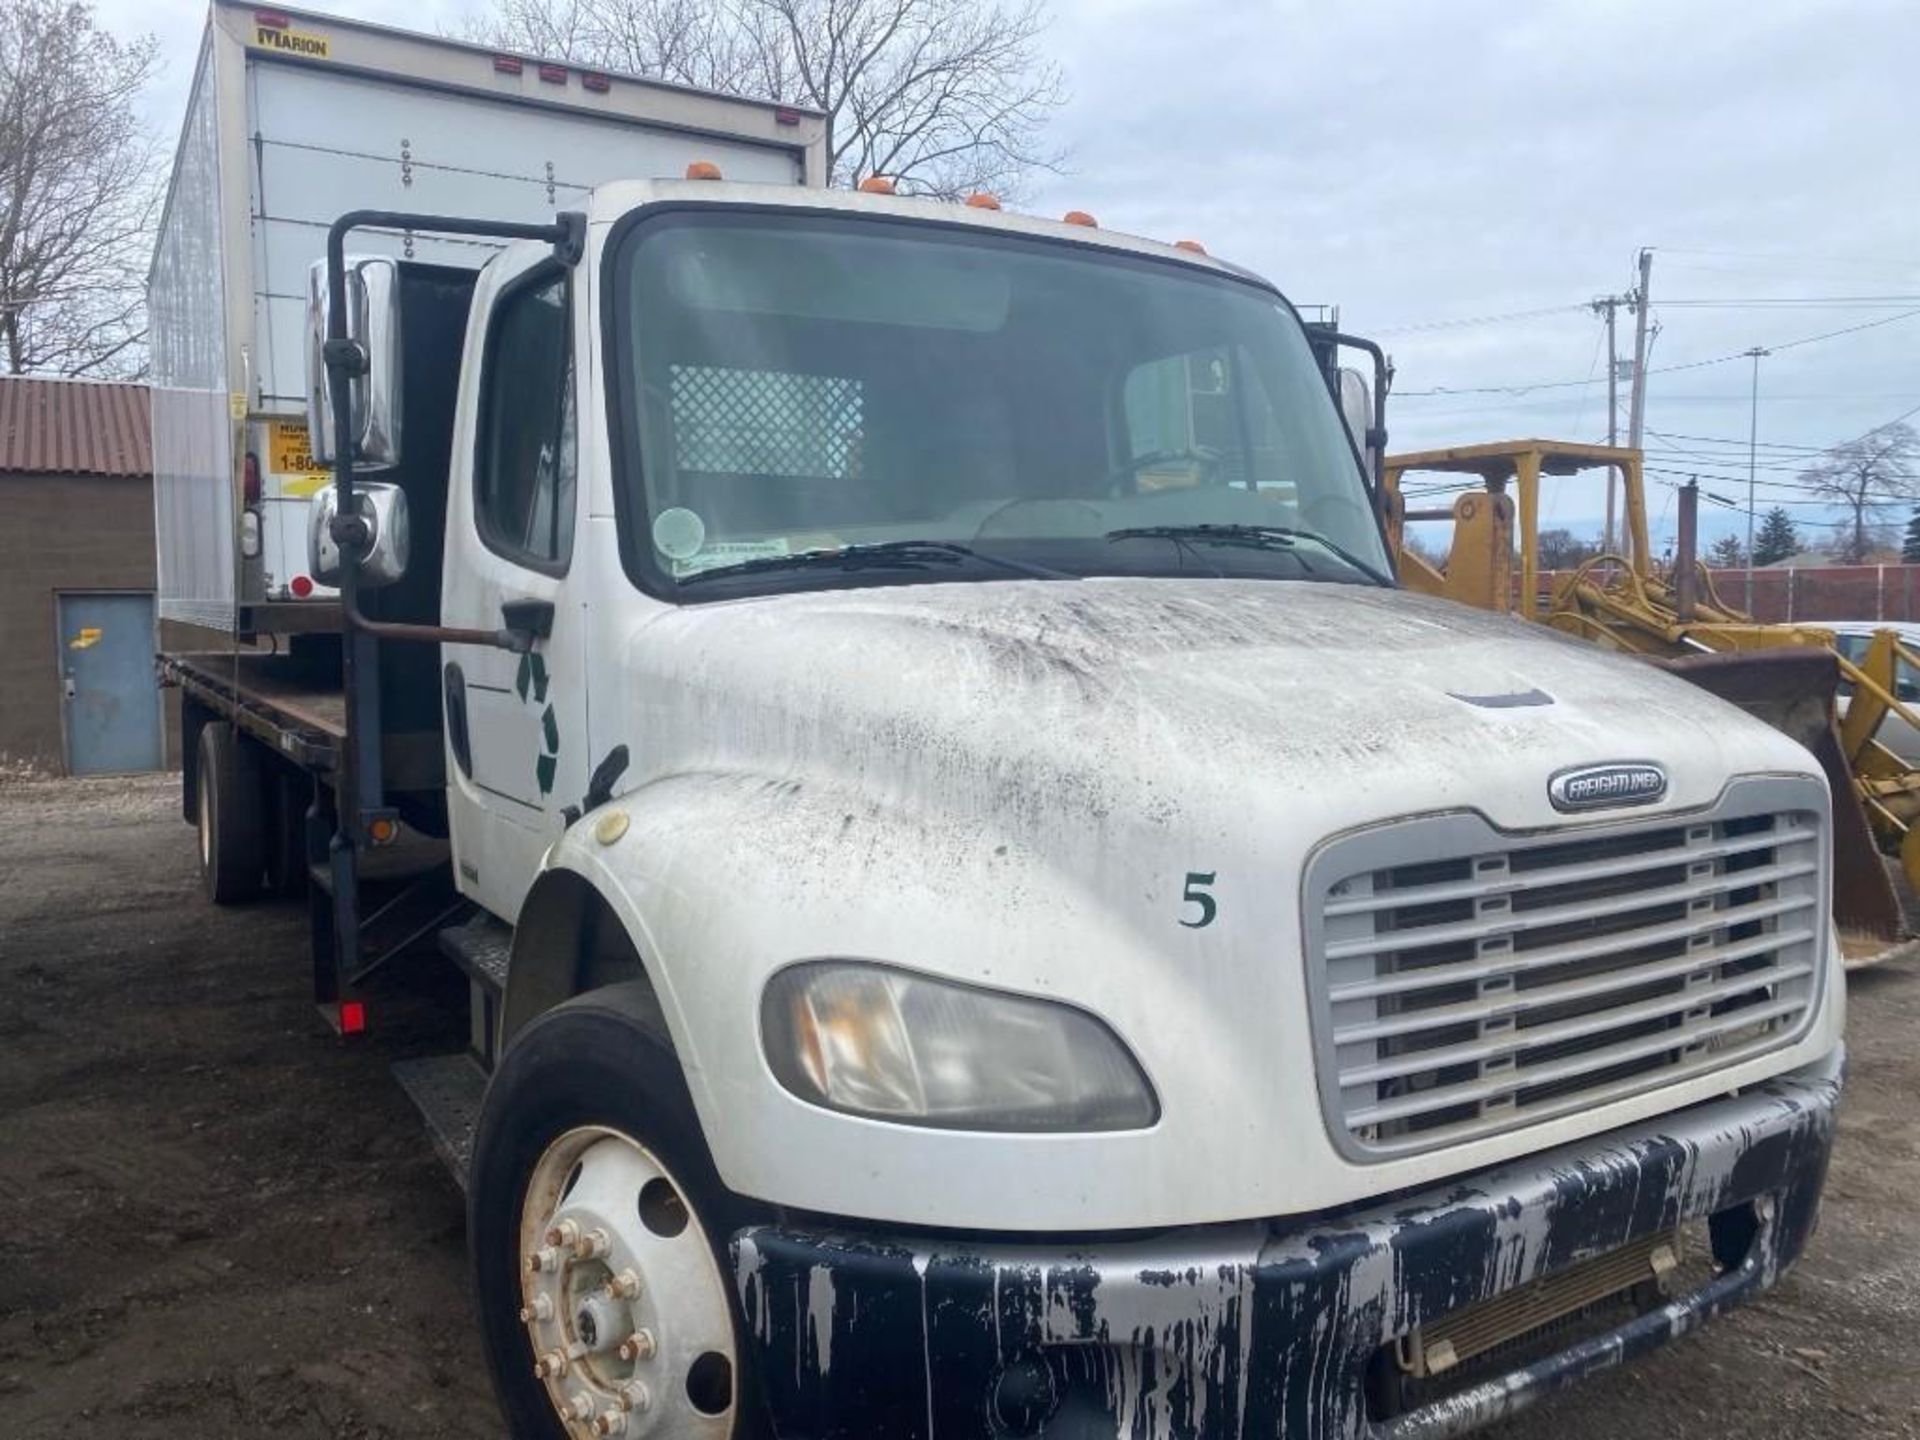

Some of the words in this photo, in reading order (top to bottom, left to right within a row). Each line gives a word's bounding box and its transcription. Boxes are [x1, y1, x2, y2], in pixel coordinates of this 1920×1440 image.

[258, 28, 326, 56] MARION
[1569, 772, 1659, 798] FREIGHTLINER
[1179, 871, 1216, 928] 5
